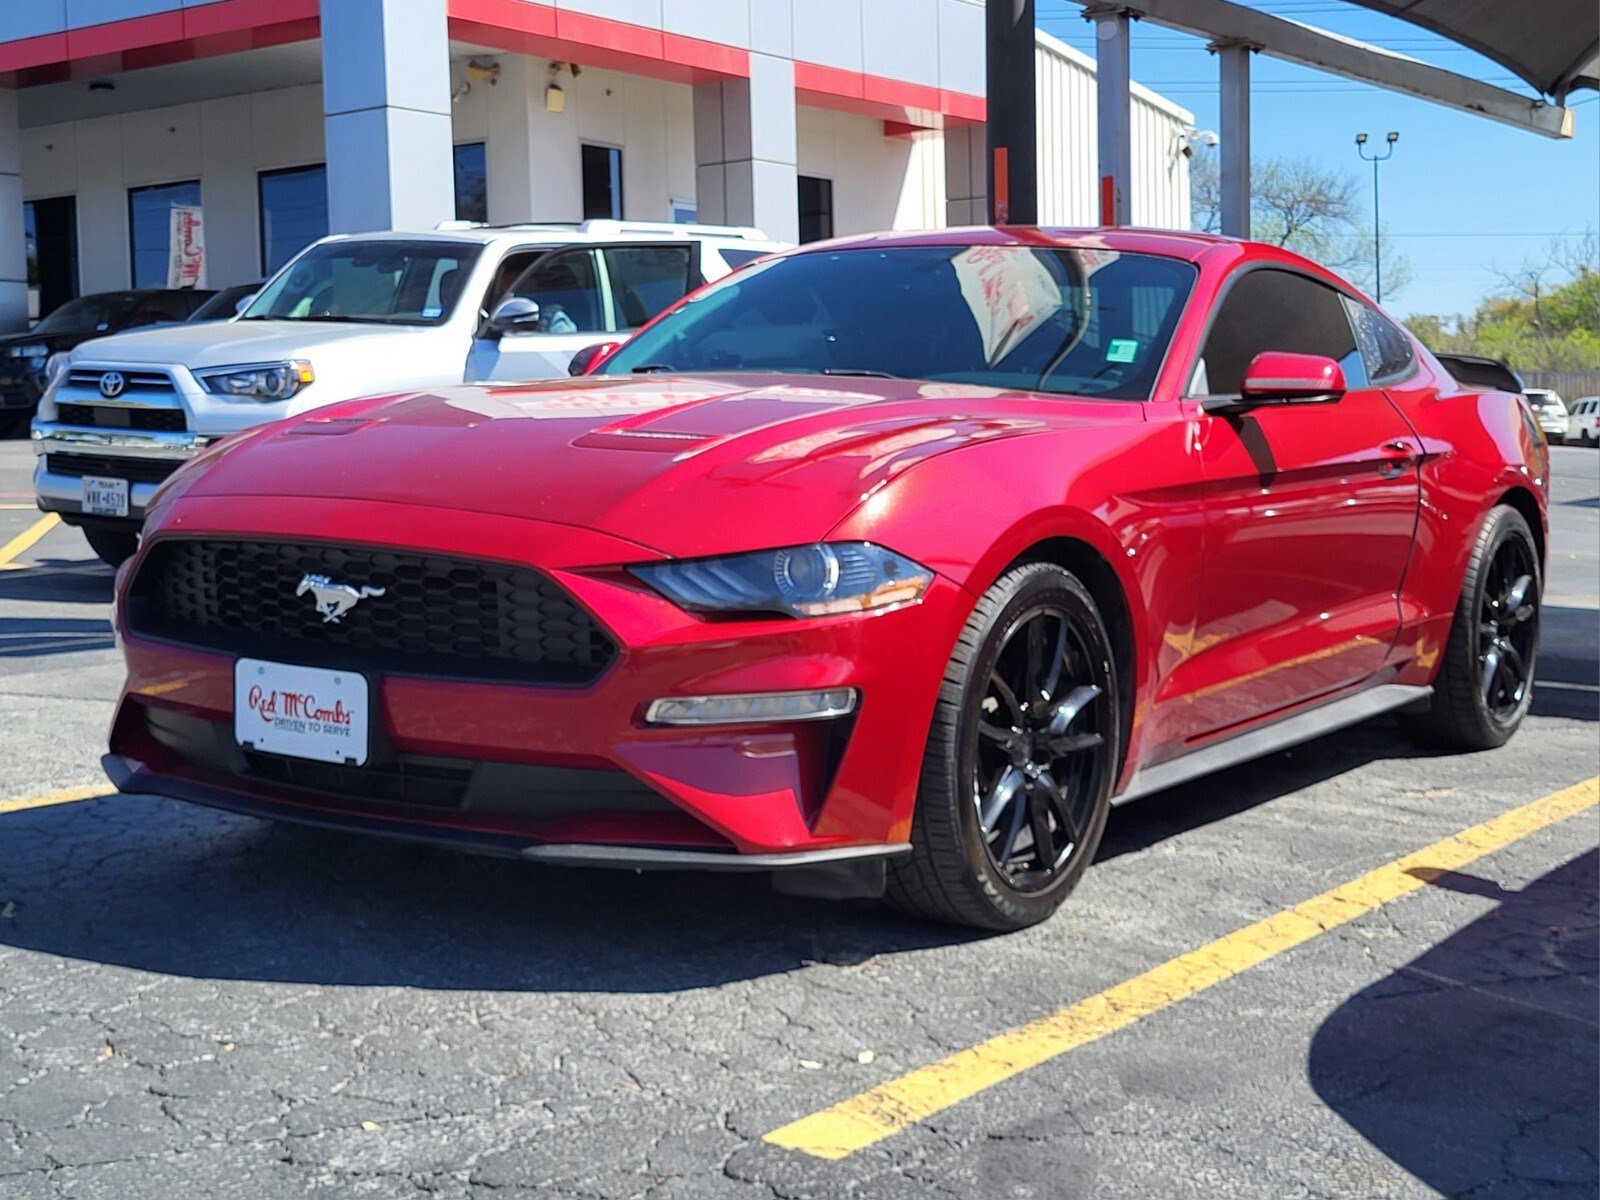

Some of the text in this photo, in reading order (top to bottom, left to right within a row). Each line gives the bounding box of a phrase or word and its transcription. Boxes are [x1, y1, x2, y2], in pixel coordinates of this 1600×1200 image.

[248, 684, 351, 725] Red McCombs
[274, 716, 351, 737] DRIVEN TO SERVE
